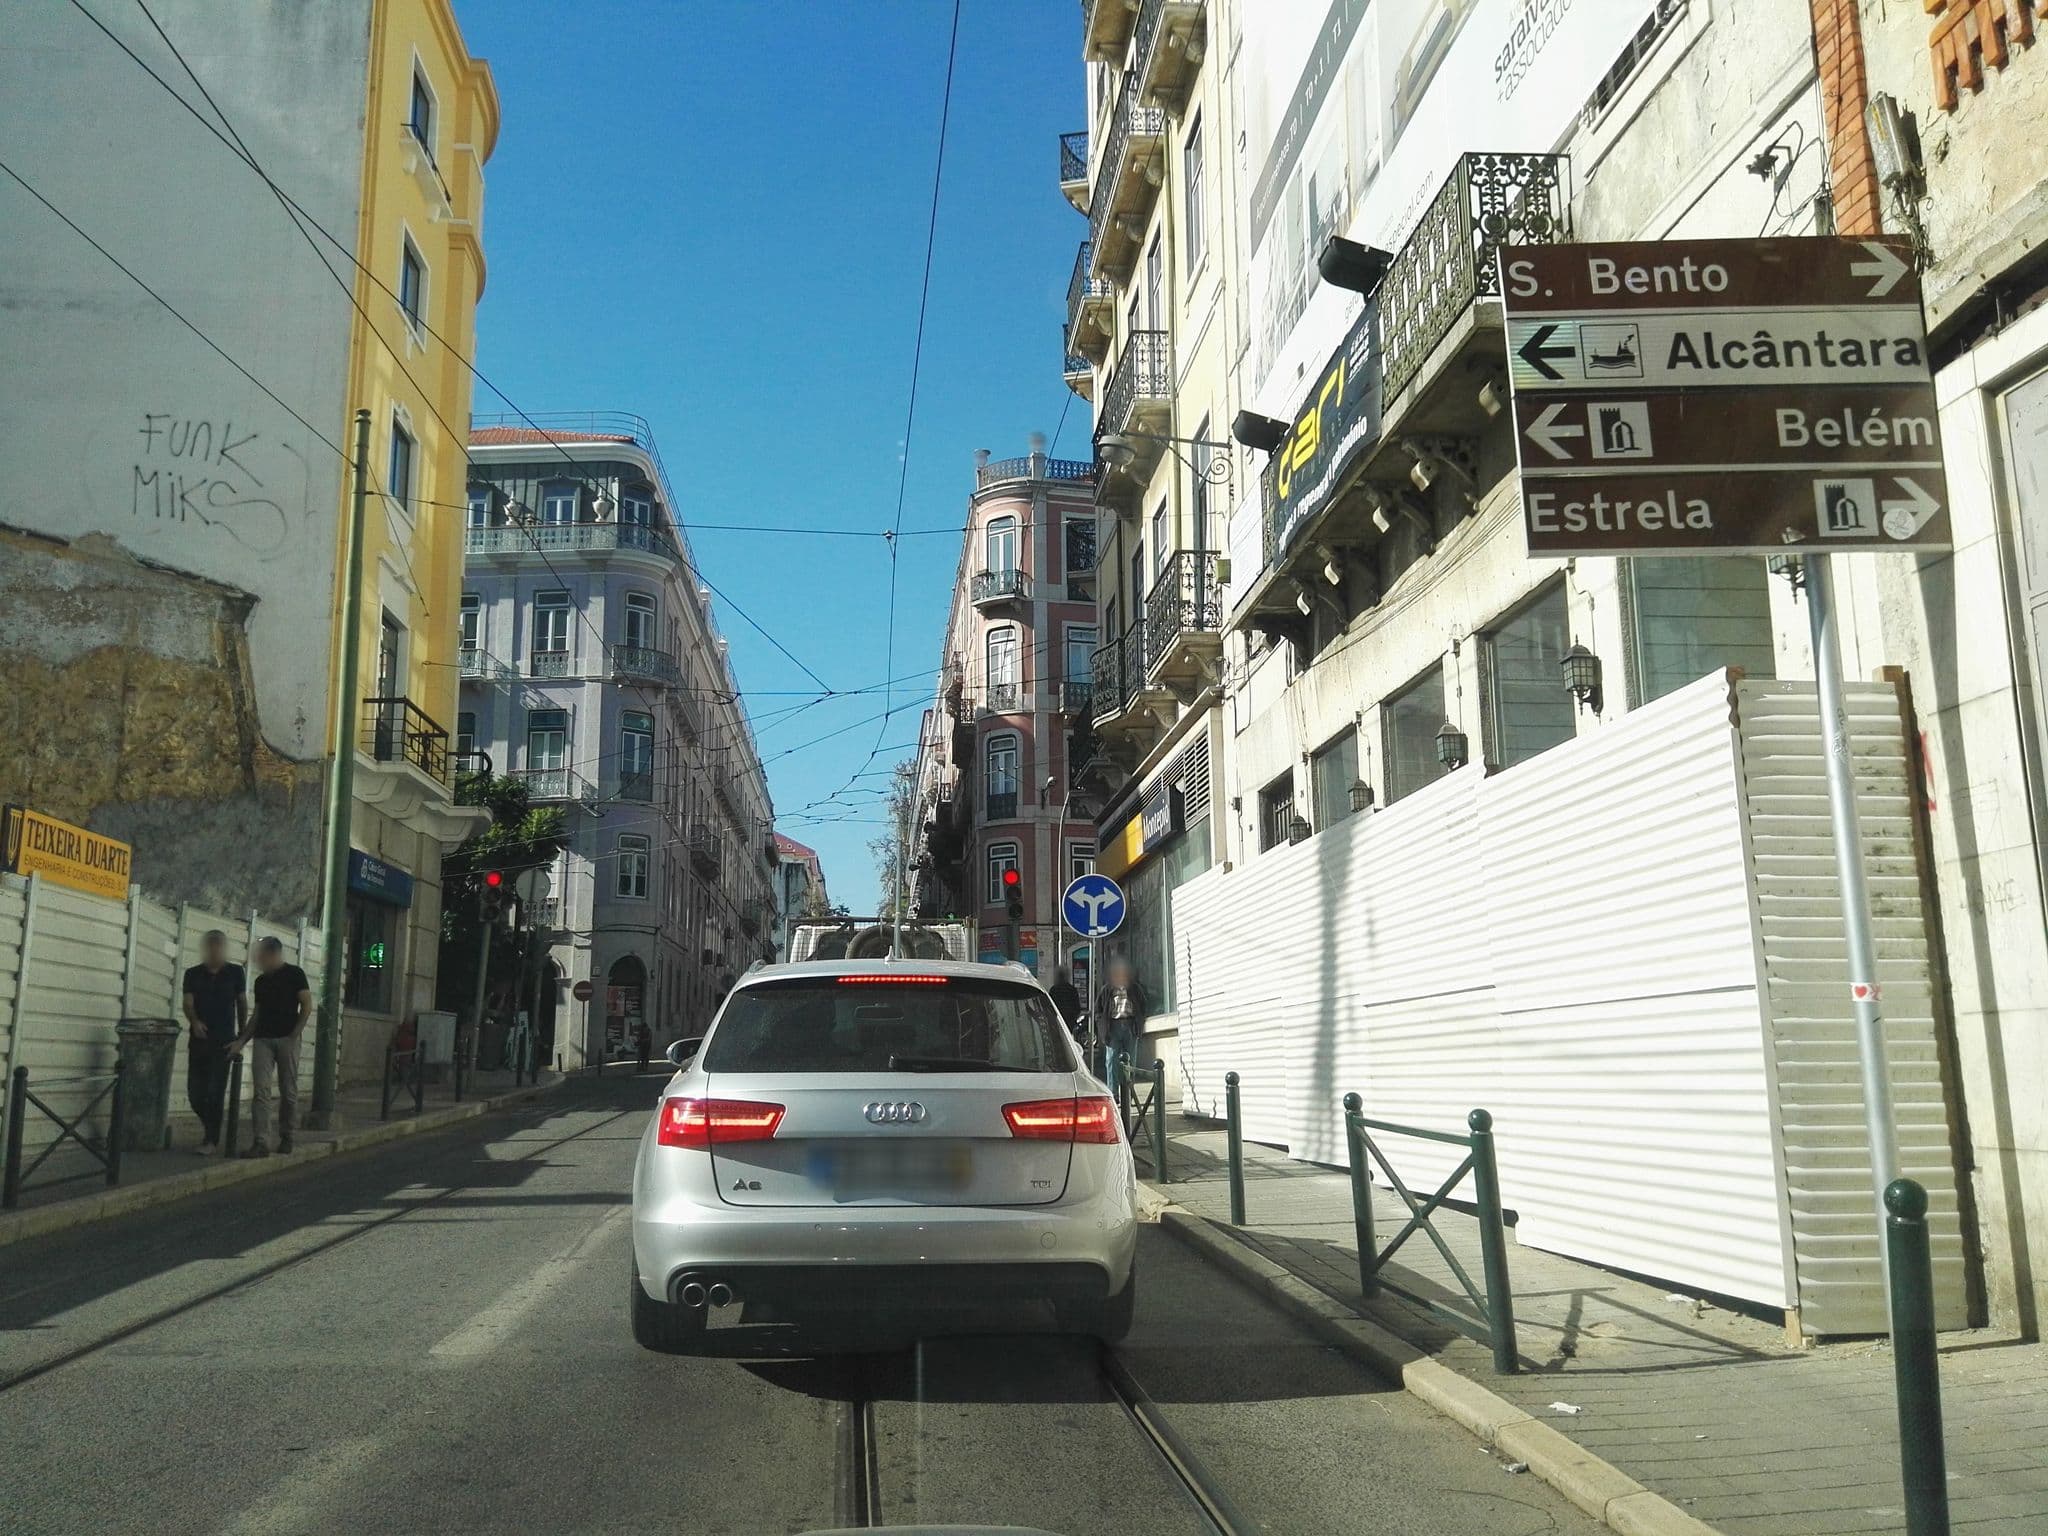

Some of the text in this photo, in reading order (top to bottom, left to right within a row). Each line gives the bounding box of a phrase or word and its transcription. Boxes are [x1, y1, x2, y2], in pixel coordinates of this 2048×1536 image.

[1508, 256, 1729, 297] S. Bento
[1666, 330, 1921, 370] Alcântara
[1776, 407, 1933, 448] Belém
[1529, 489, 1714, 533] Estrela
[1142, 798, 1170, 843] Montepio
[26, 817, 129, 876] TEIXEIRA DUARTE
